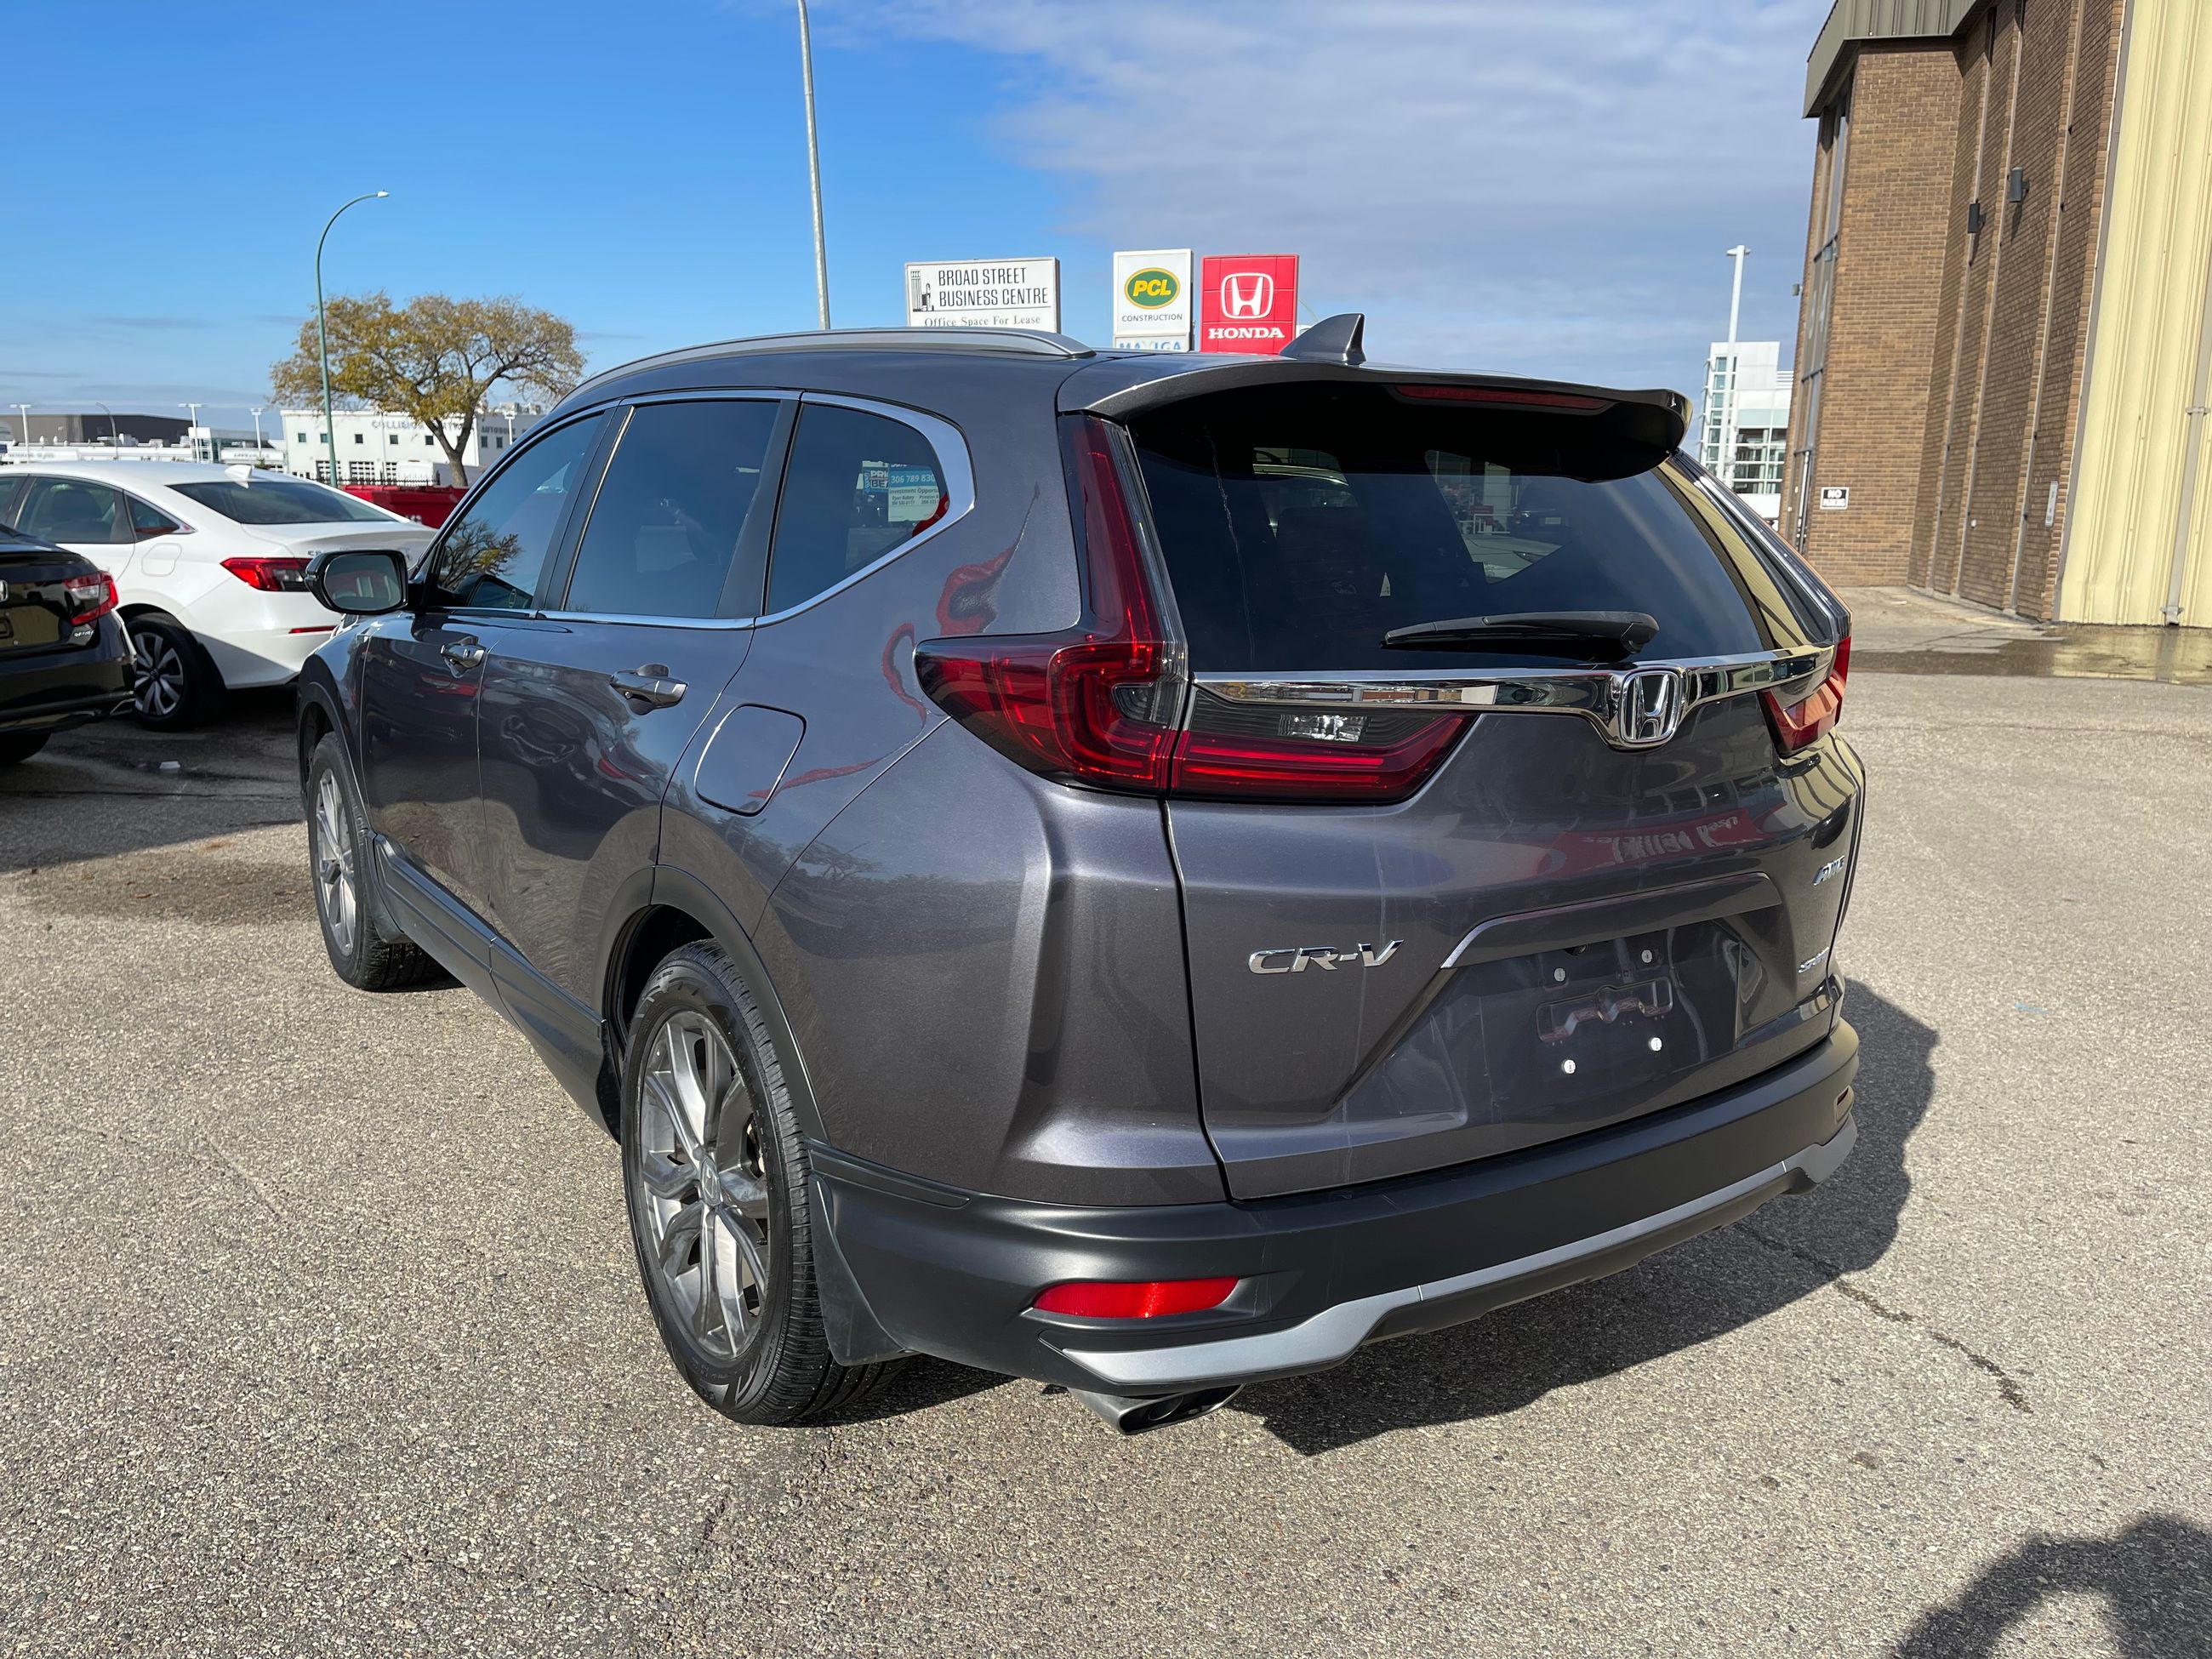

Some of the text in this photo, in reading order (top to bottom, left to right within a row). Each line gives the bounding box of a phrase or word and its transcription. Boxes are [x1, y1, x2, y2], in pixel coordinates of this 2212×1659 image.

[938, 267, 1027, 287] BROAD STREET
[1132, 279, 1172, 296] PCL
[939, 288, 1048, 307] BUSINESS CENTRE
[924, 315, 1040, 327] Office Space For Lease
[1121, 313, 1183, 322] CONSTRUCTION
[1208, 327, 1285, 339] HONDA
[1248, 939, 1405, 975] CR-V
